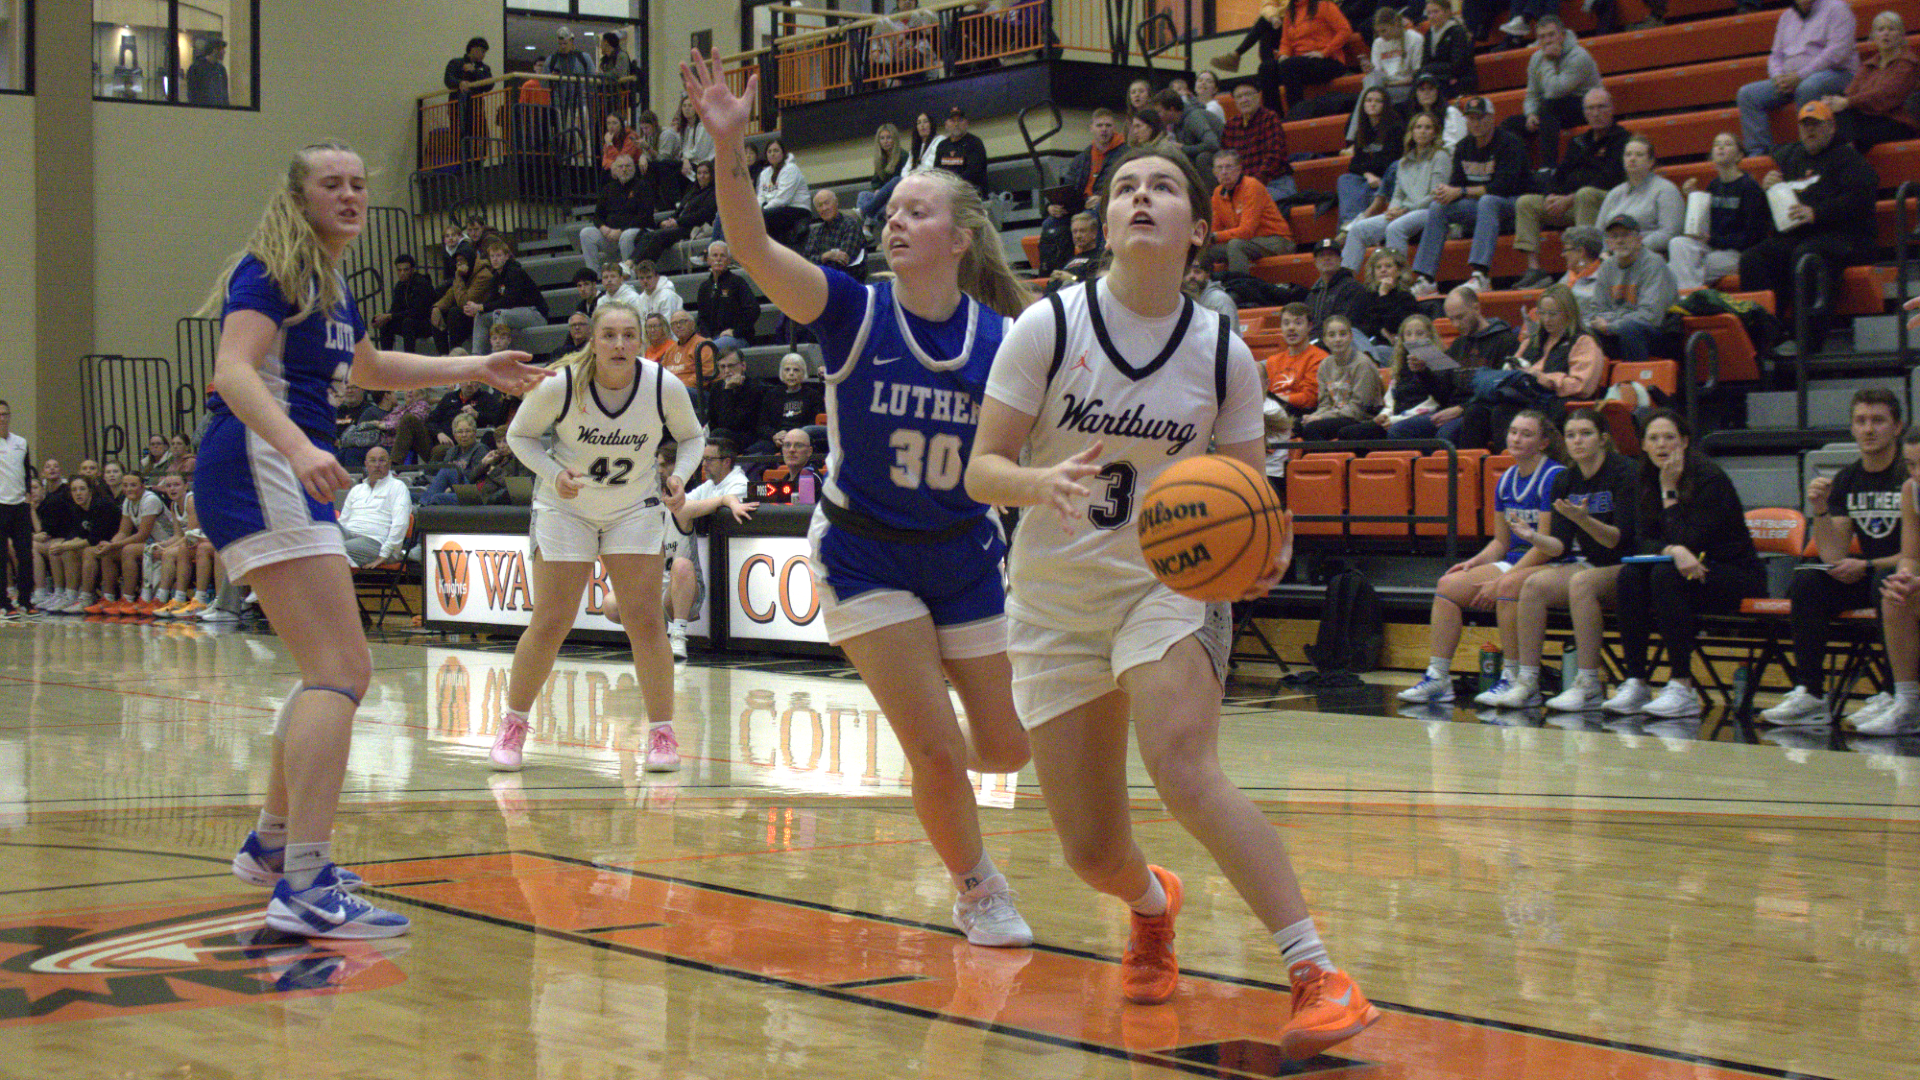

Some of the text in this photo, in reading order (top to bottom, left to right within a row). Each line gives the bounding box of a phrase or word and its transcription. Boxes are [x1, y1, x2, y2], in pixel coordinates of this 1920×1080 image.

[577, 425, 649, 451] Wartburg
[1057, 393, 1198, 456] Wartburg
[588, 456, 635, 486] 42
[888, 428, 963, 490] 30
[1088, 460, 1138, 531] 3
[1151, 542, 1213, 577] NCAA
[438, 578, 468, 598] Knights
